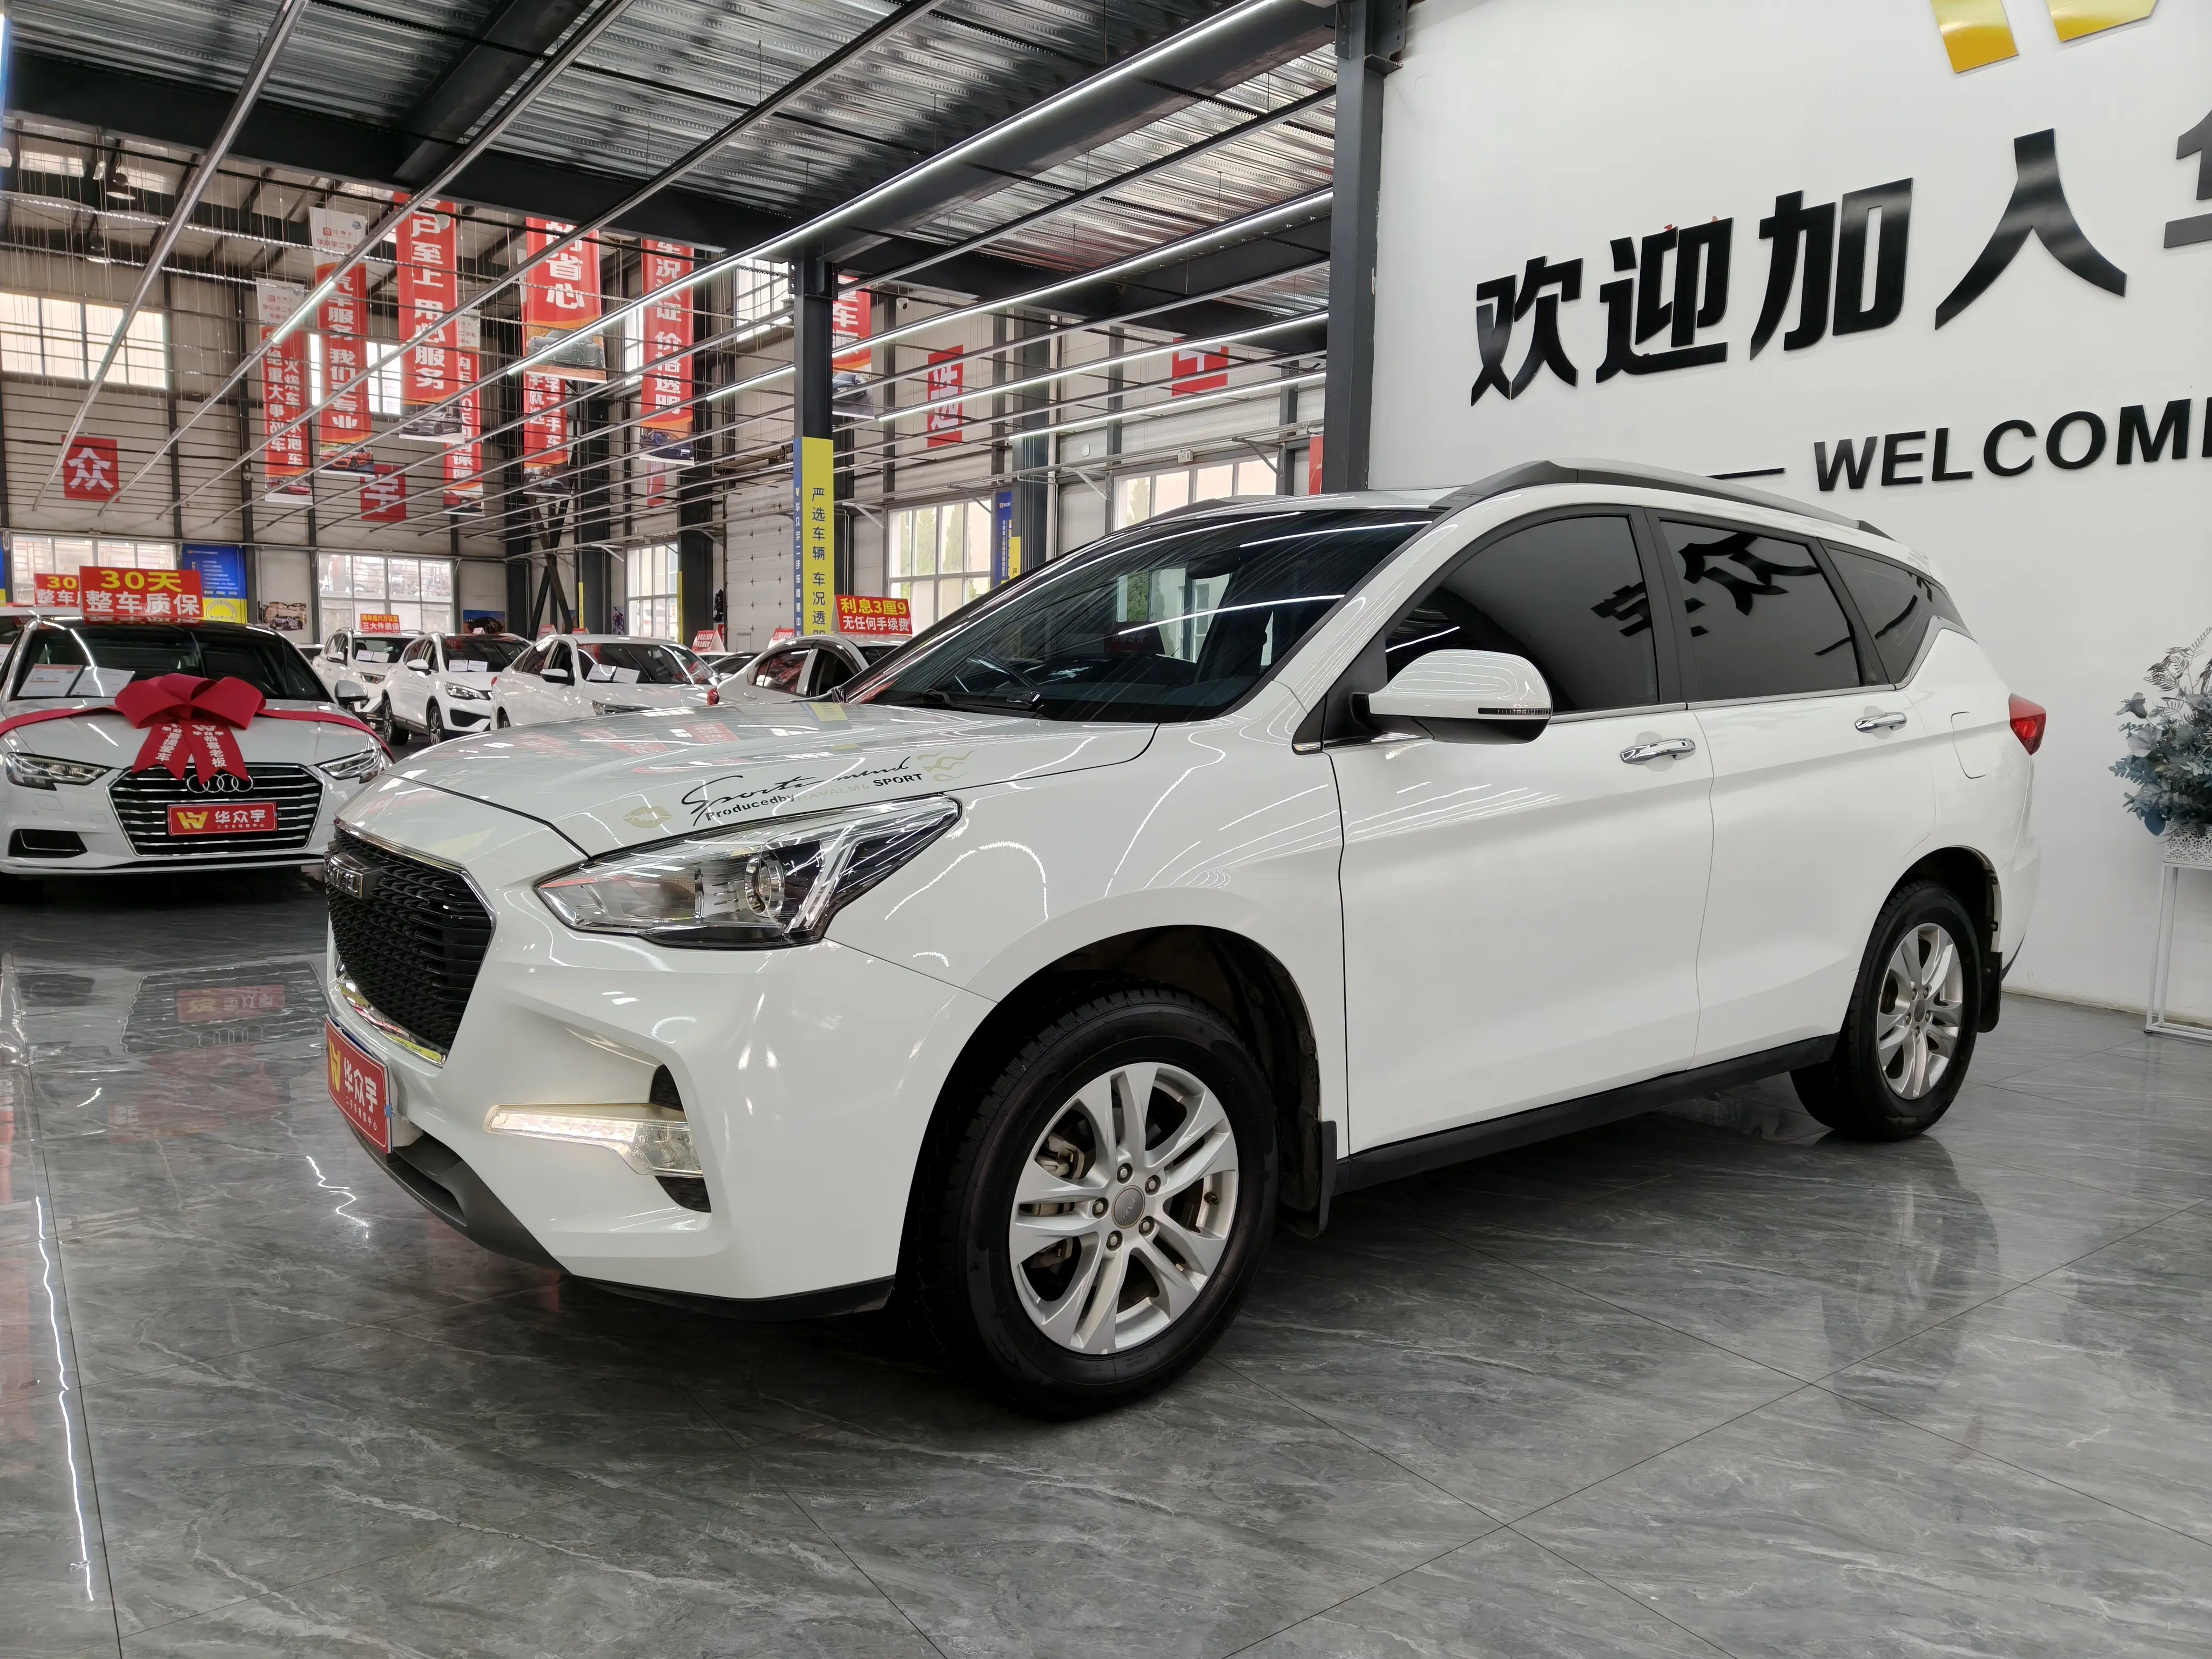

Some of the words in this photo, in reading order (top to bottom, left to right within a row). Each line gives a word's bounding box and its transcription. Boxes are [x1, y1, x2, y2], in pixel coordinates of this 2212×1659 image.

[415, 298, 446, 389] 用心服务
[655, 331, 681, 414] 价格透明
[1813, 397, 2212, 492] WELCOM
[67, 447, 111, 492] 众
[812, 487, 825, 560] 严选车辆
[47, 576, 77, 589] 30
[100, 570, 183, 592] 30天
[36, 589, 80, 604] 整车
[85, 591, 200, 616] 整车质保
[840, 598, 906, 615] 利息3厘9
[842, 616, 909, 631] 无任何手续费
[873, 773, 922, 787] SPORT
[214, 809, 266, 824] 华众宇
[343, 1056, 378, 1114] 华众宇
